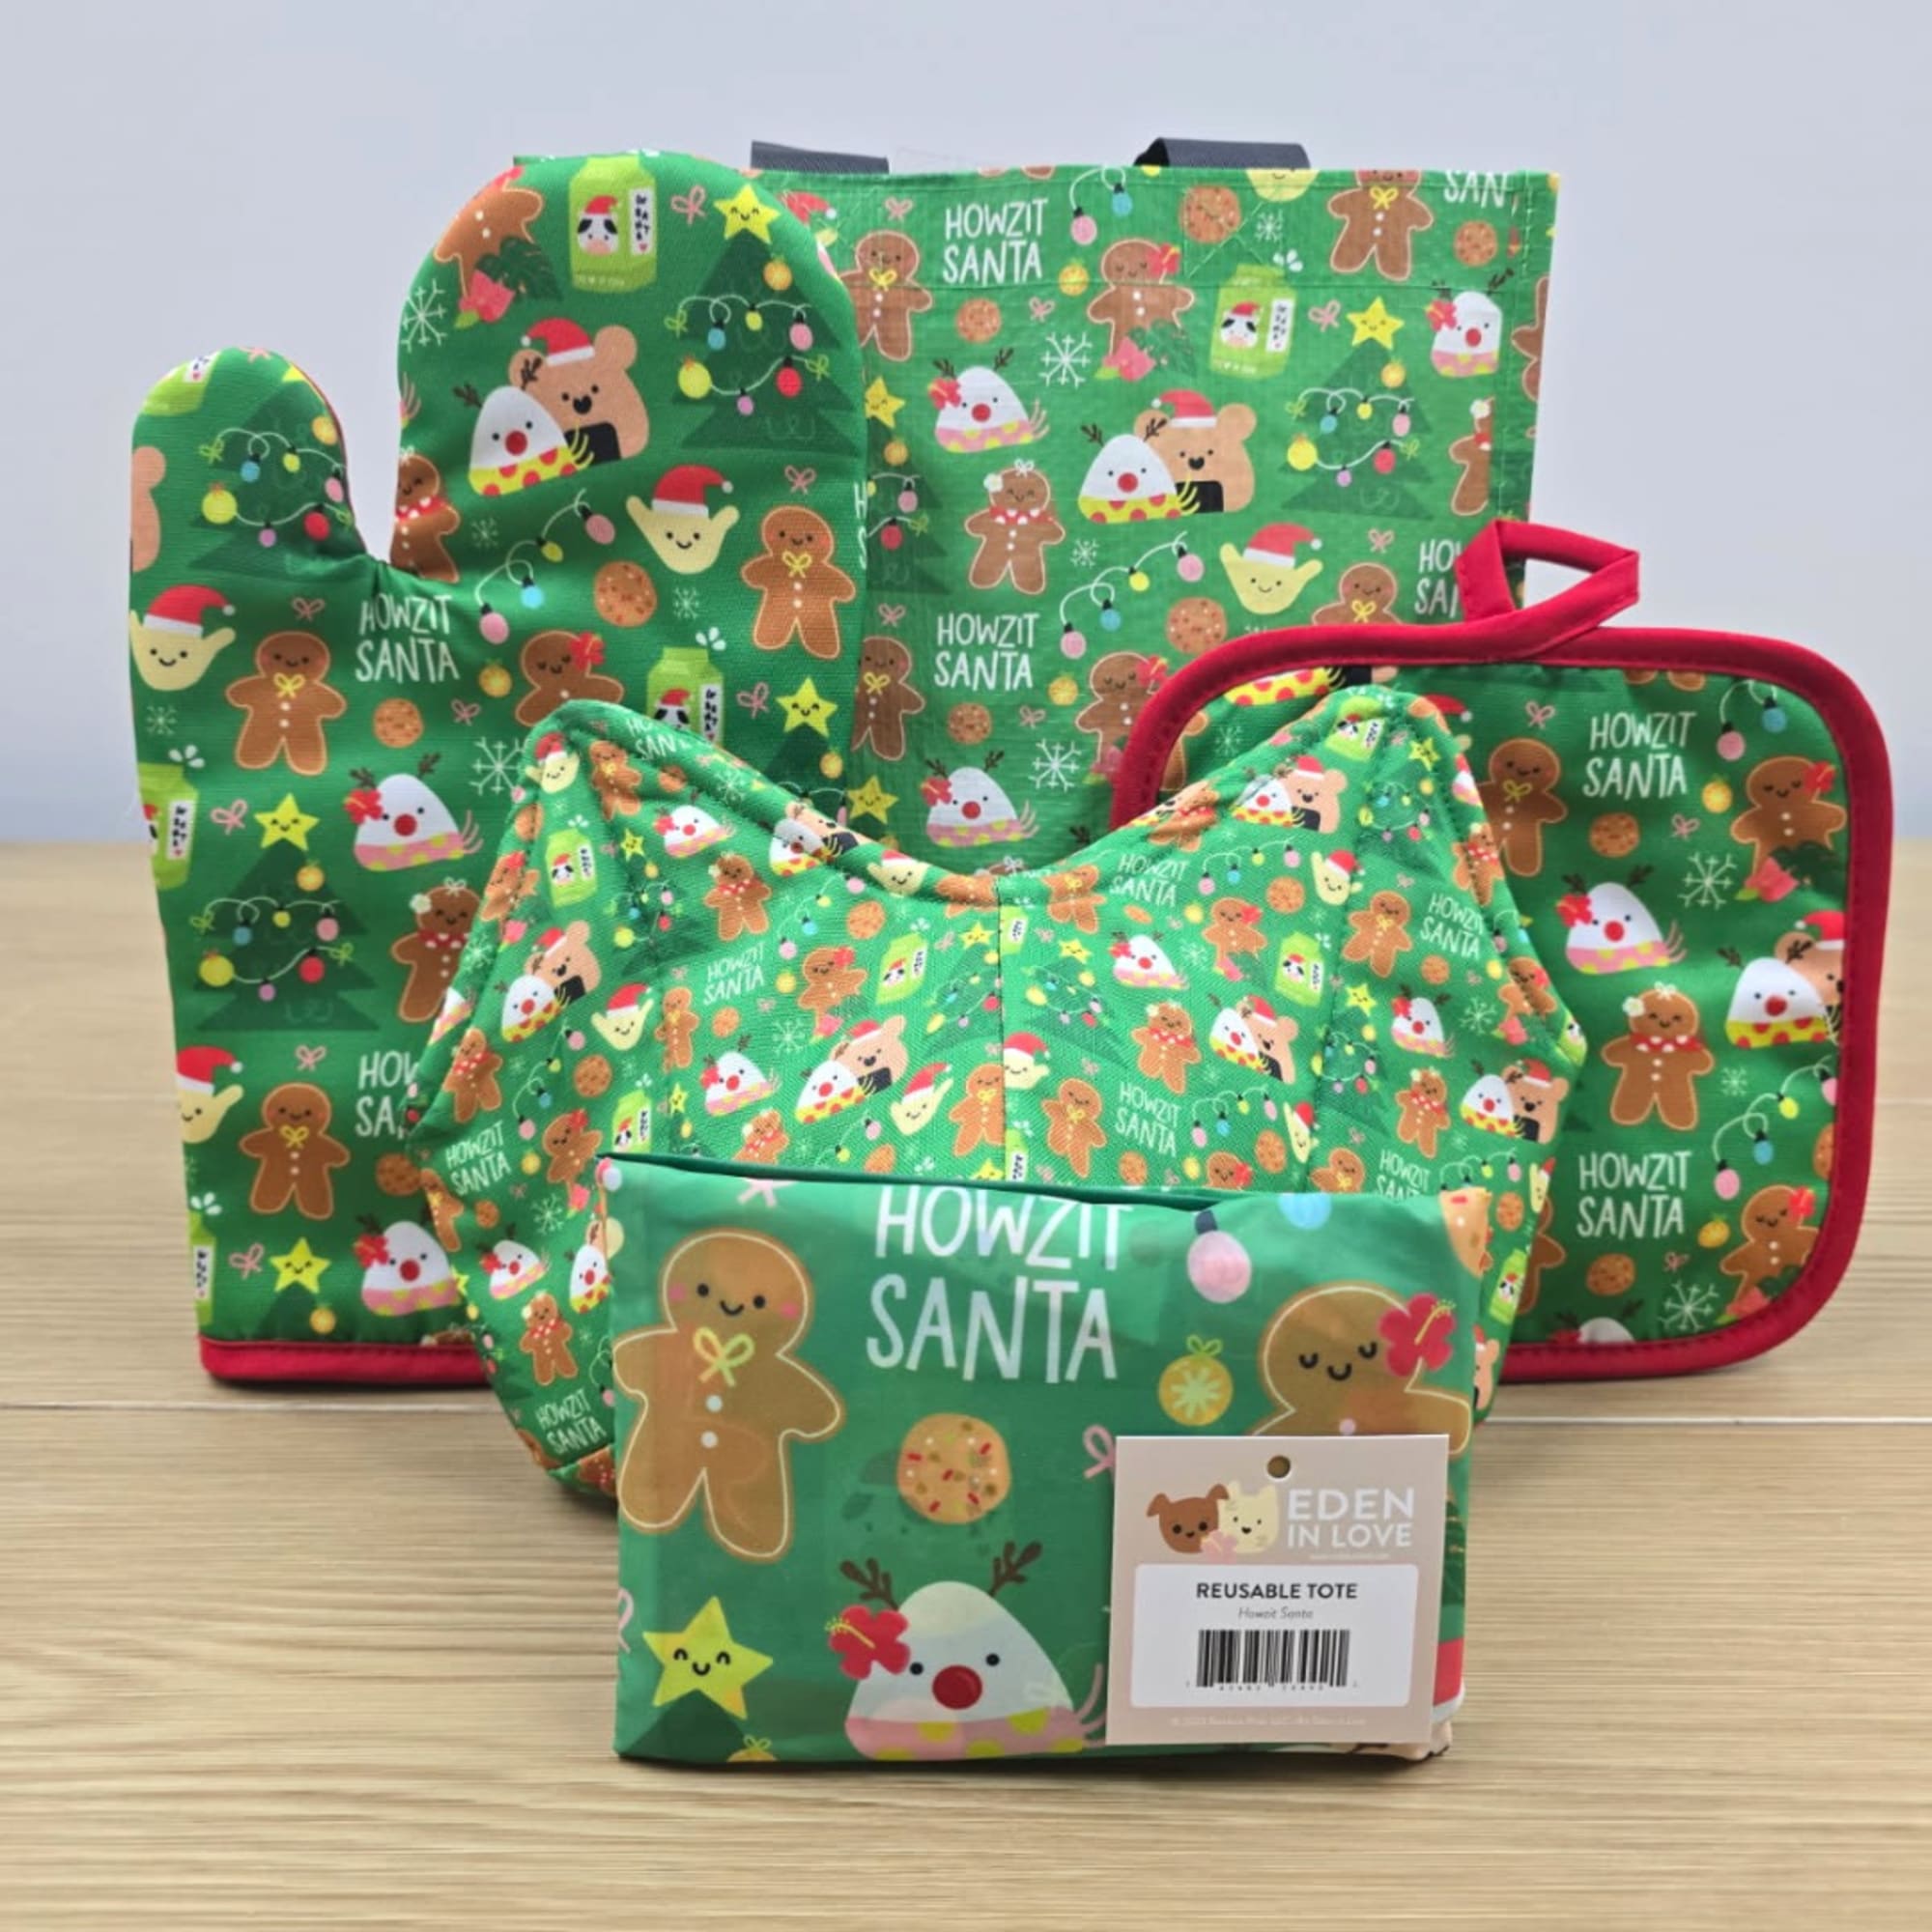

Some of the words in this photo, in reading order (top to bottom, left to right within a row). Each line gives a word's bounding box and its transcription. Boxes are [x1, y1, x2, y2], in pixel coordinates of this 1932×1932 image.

[945, 197, 1049, 241] HOWZIT
[943, 240, 1043, 288] SANTA
[359, 592, 453, 636] HOWZIT
[937, 612, 1041, 648] HOWZIT
[355, 636, 461, 684] SANTA
[934, 650, 1034, 692] SANTA
[1589, 712, 1698, 752] HOWZIT
[1582, 753, 1688, 801] SANTA
[1109, 875, 1177, 907] SANTA
[1420, 916, 1481, 961] SANTA
[703, 964, 766, 1006] SANTA
[1120, 1081, 1182, 1129] HOWZIT
[444, 1120, 504, 1169] HOWZIT
[1115, 1107, 1178, 1158] SANTA
[450, 1150, 512, 1197] SANTA
[1379, 1150, 1431, 1194] HOWZIT
[1578, 1151, 1692, 1191] HOWZIT
[875, 1184, 1135, 1271] HOWZIT
[1577, 1194, 1684, 1240] SANTA
[867, 1273, 1118, 1384] SANTA
[535, 1388, 591, 1431] HOWZIT
[547, 1416, 609, 1455] SANTA
[1288, 1488, 1415, 1520] EDEN
[1288, 1523, 1321, 1548] IN
[1331, 1522, 1413, 1548] LOVE
[1196, 1582, 1302, 1599] REUSABLE
[1306, 1582, 1358, 1599] TOTE
